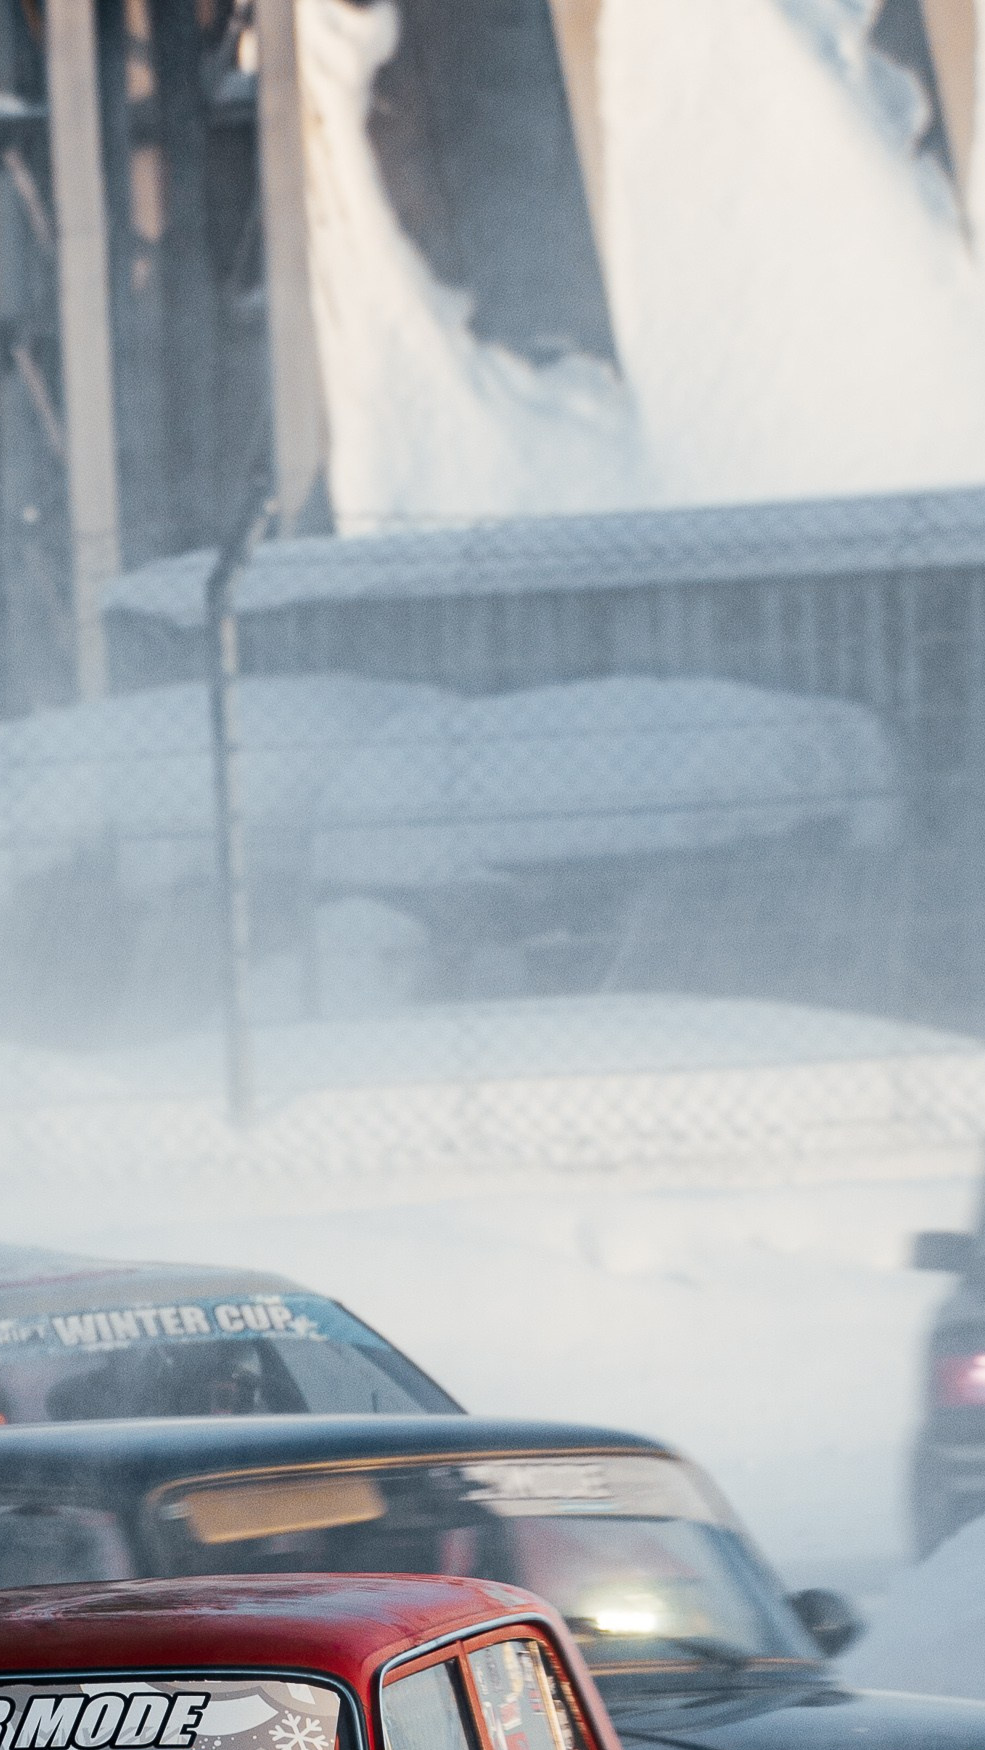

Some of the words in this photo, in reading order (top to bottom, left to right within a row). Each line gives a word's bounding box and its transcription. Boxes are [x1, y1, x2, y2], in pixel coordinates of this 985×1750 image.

[52, 1306, 210, 1346] WINTER
[213, 1303, 294, 1333] CUP
[14, 1695, 207, 1750] MODE
